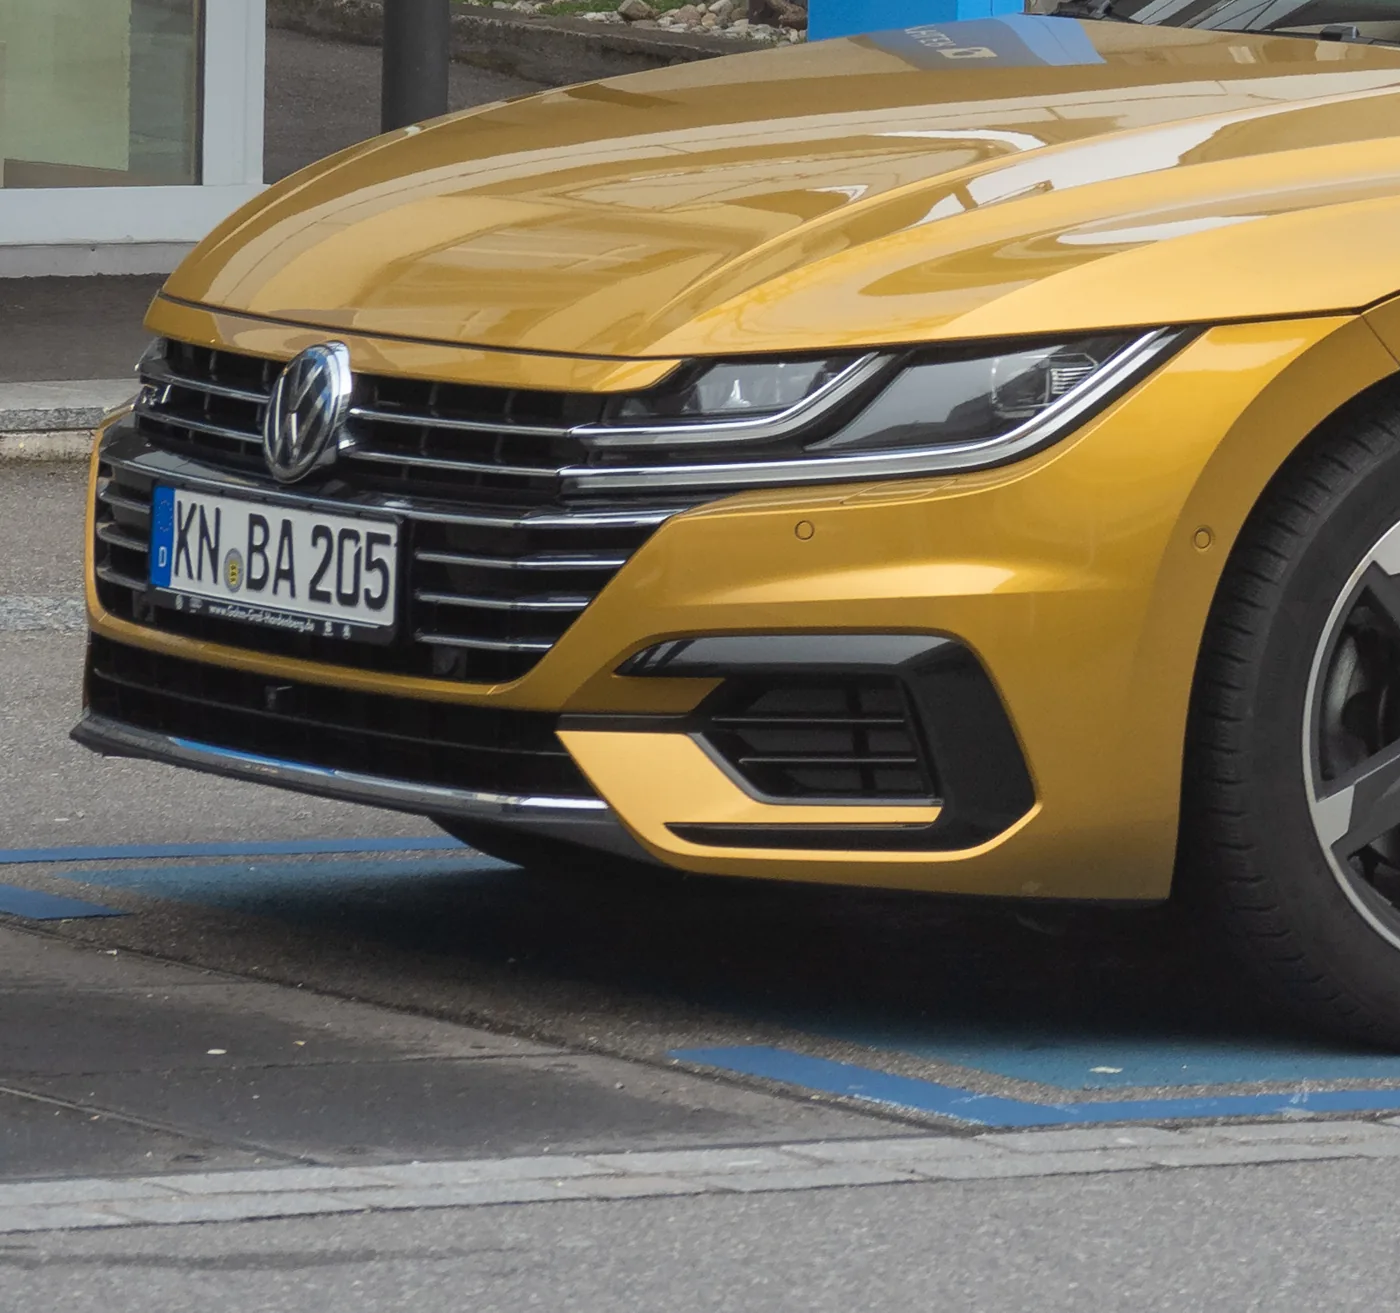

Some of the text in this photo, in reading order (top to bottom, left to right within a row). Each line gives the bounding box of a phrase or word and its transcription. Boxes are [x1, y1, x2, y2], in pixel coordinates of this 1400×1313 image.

[174, 499, 393, 611] KN BA 205
